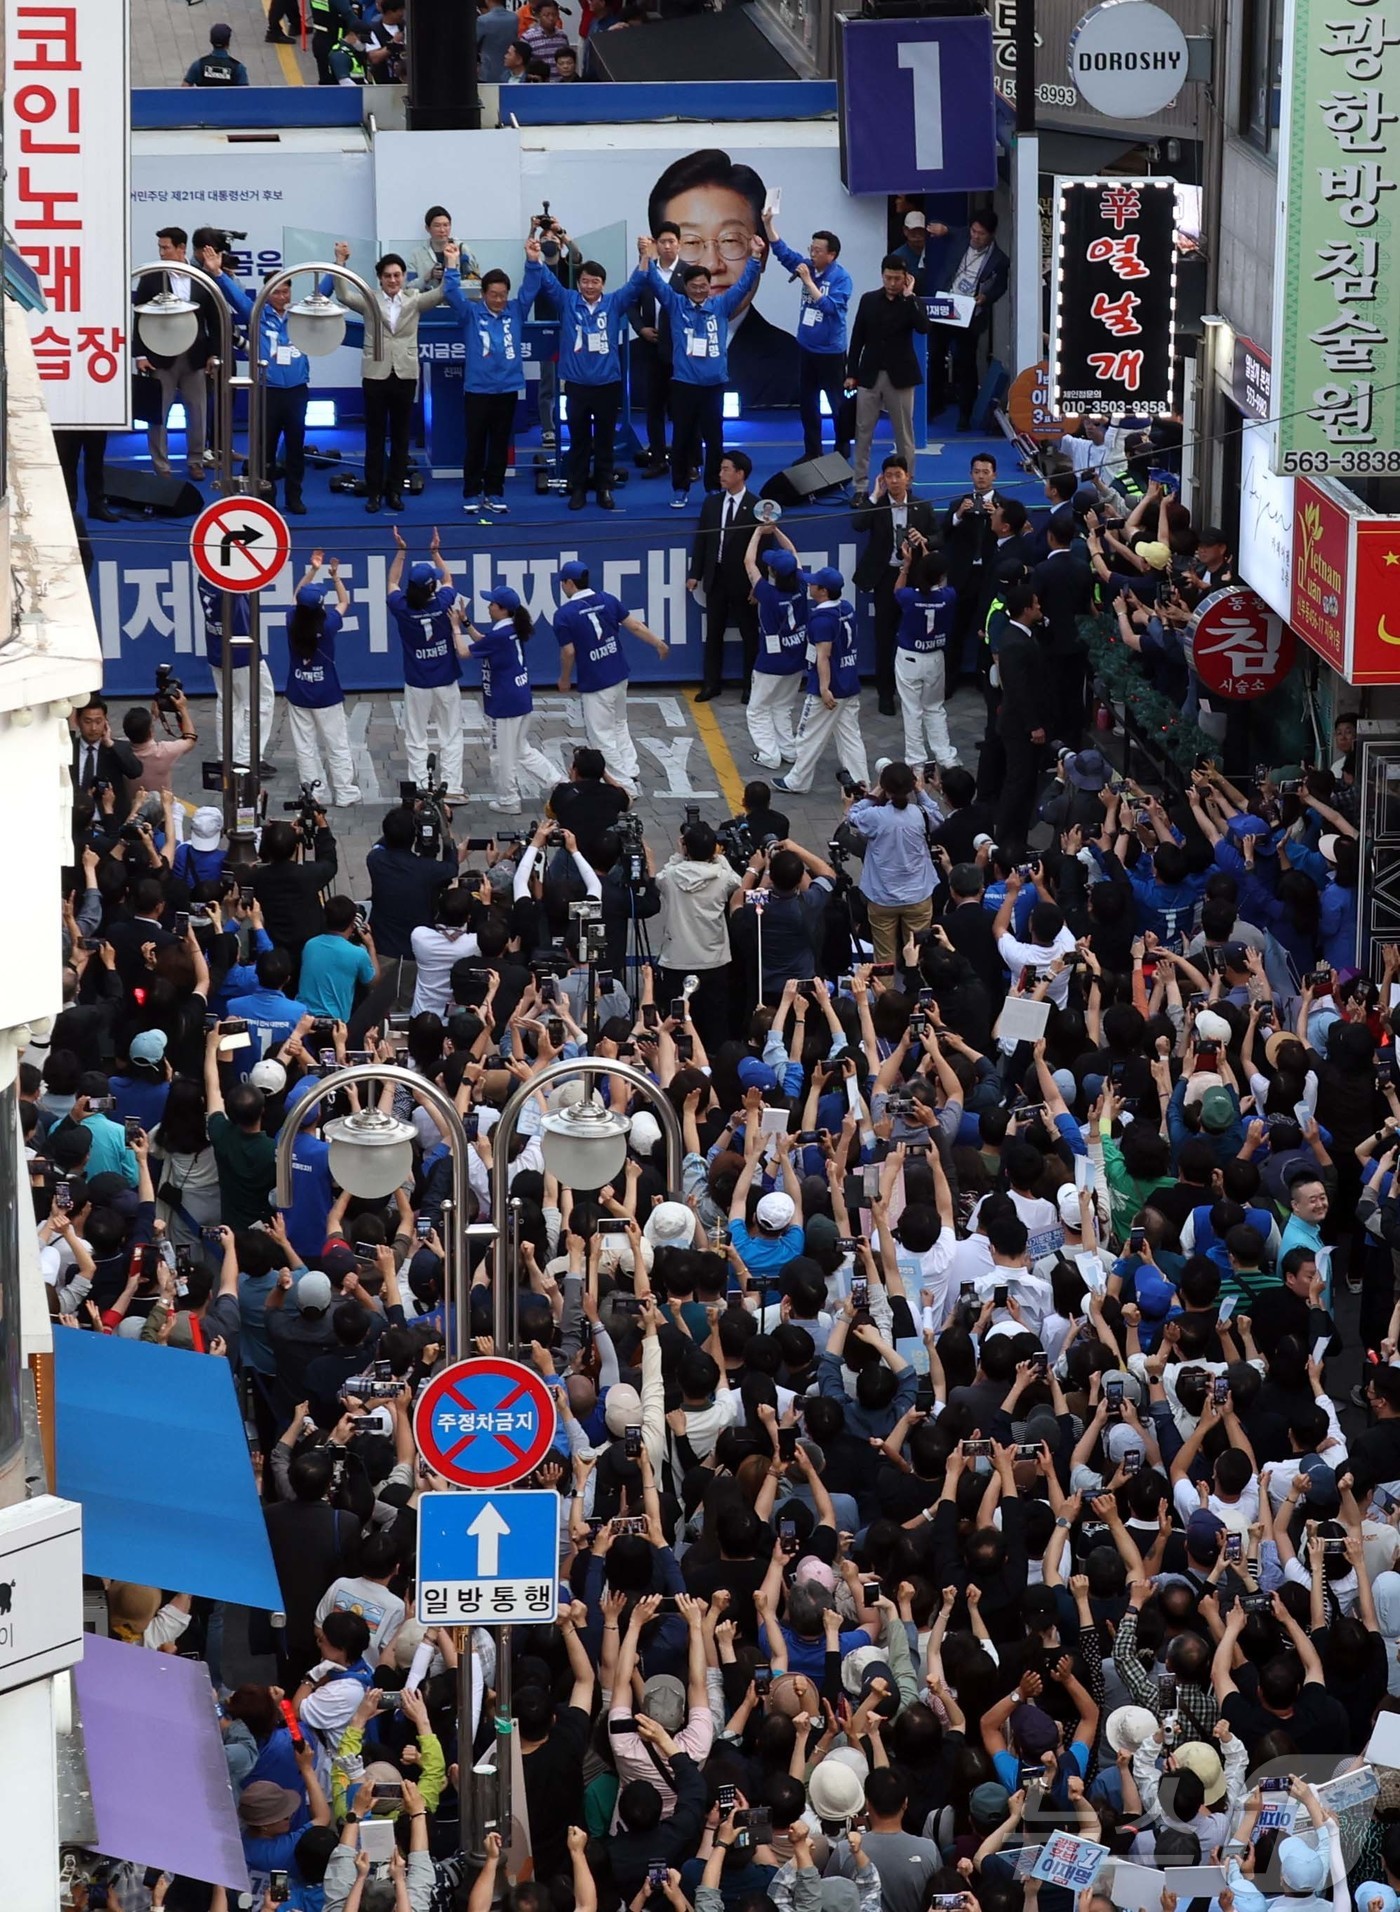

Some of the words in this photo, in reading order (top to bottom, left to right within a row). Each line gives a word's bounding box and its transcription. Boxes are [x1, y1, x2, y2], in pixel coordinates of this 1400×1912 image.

[1079, 52, 1181, 71] DOROSHY
[1003, 79, 1077, 106] 5-8993
[897, 41, 943, 171] 1
[172, 190, 205, 201] 제21대
[208, 190, 259, 201] 대통령선거
[263, 190, 283, 201] 후보
[1307, 0, 1400, 444] 광한방침술원
[231, 250, 282, 276] 금은
[31, 326, 126, 383] 습장
[419, 343, 466, 359] 지금은
[1062, 400, 1167, 414] 010-3503-9358
[1283, 452, 1400, 473] 563-3838
[925, 609, 935, 634] 1
[415, 644, 448, 659] 이재명
[589, 641, 618, 661] 이재명
[914, 638, 946, 650] 이재명
[1198, 612, 1283, 677] 침
[1219, 678, 1265, 694] 시술소
[437, 1411, 533, 1433] 주정차금지
[424, 1585, 551, 1615] 일방통행
[1259, 1811, 1291, 1827] 이재
[1077, 1848, 1103, 1871] 1
[1041, 1858, 1093, 1885] 이재명
